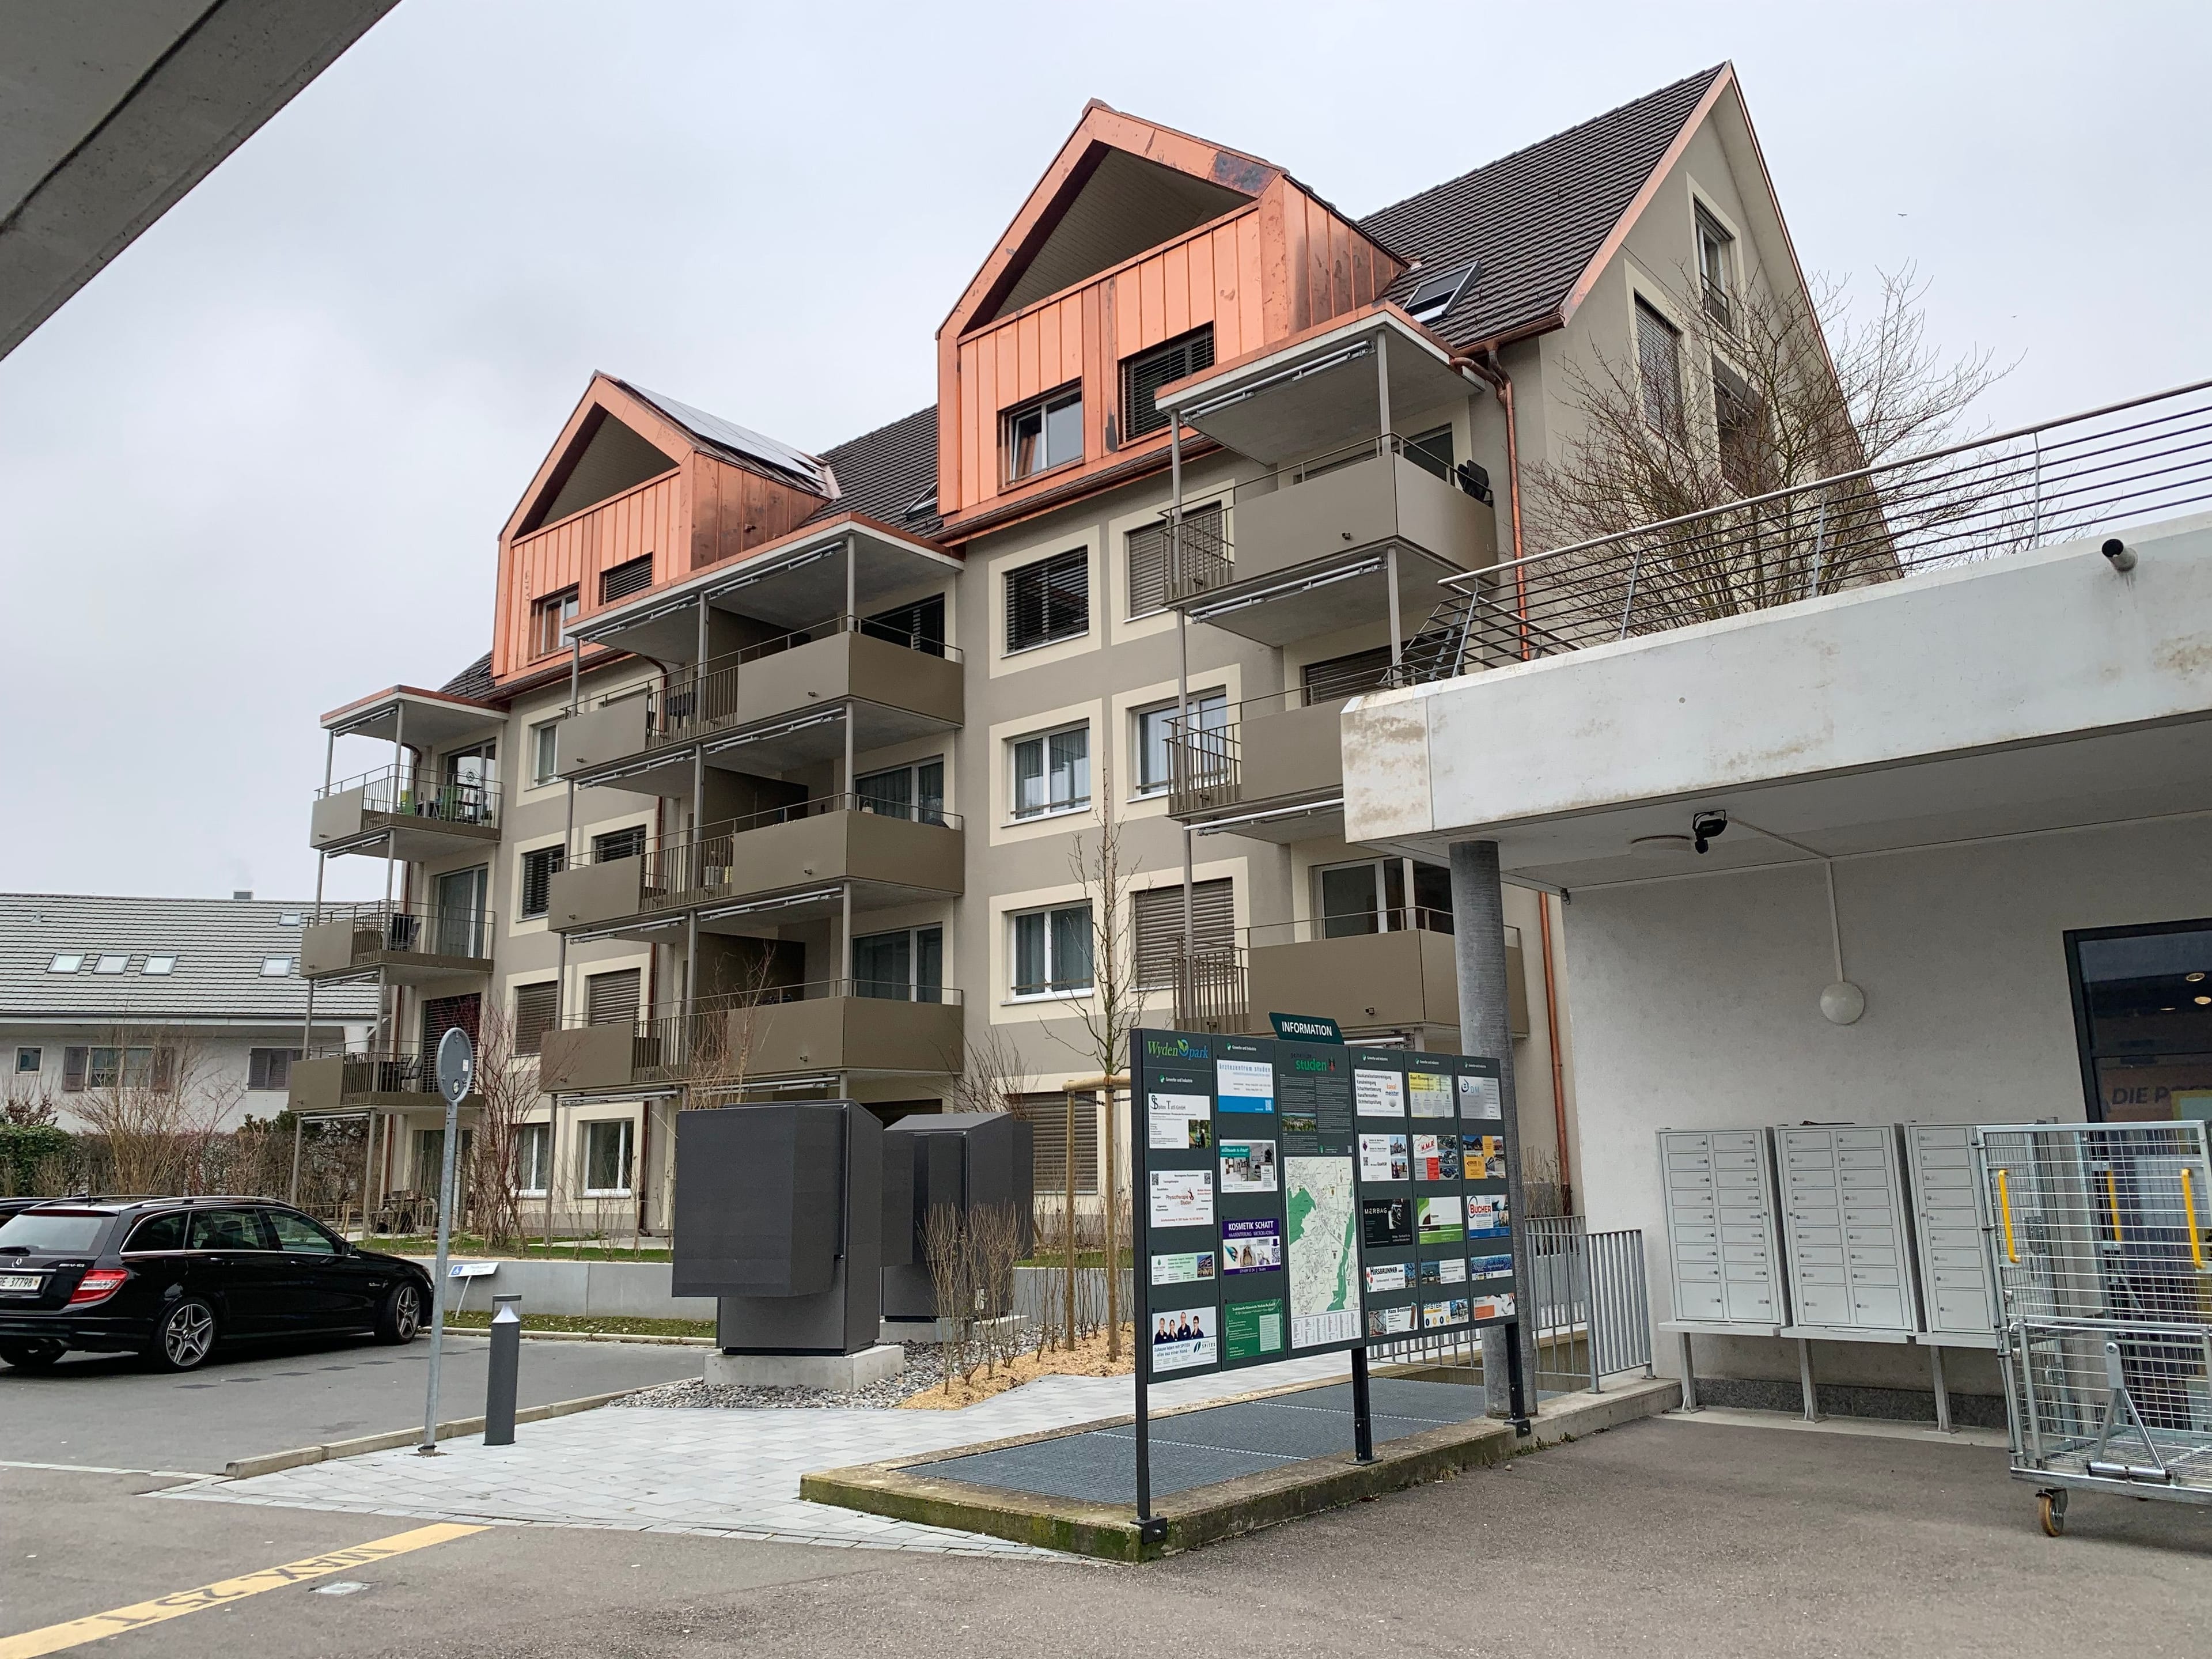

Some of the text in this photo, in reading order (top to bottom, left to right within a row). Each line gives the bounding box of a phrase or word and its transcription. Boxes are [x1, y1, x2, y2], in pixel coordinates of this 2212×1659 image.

[1282, 1021, 1332, 1036] INFORMATION
[1147, 1041, 1208, 1060] Wyden park
[1296, 1058, 1327, 1071] studen
[2111, 1087, 2149, 1105] DIE
[1470, 1204, 1491, 1214] BUCHER
[1228, 1221, 1274, 1231] KOSMETIK SCHATT
[1370, 1267, 1397, 1275] HIRSBRUNNER
[9, 1277, 33, 1287] 37798
